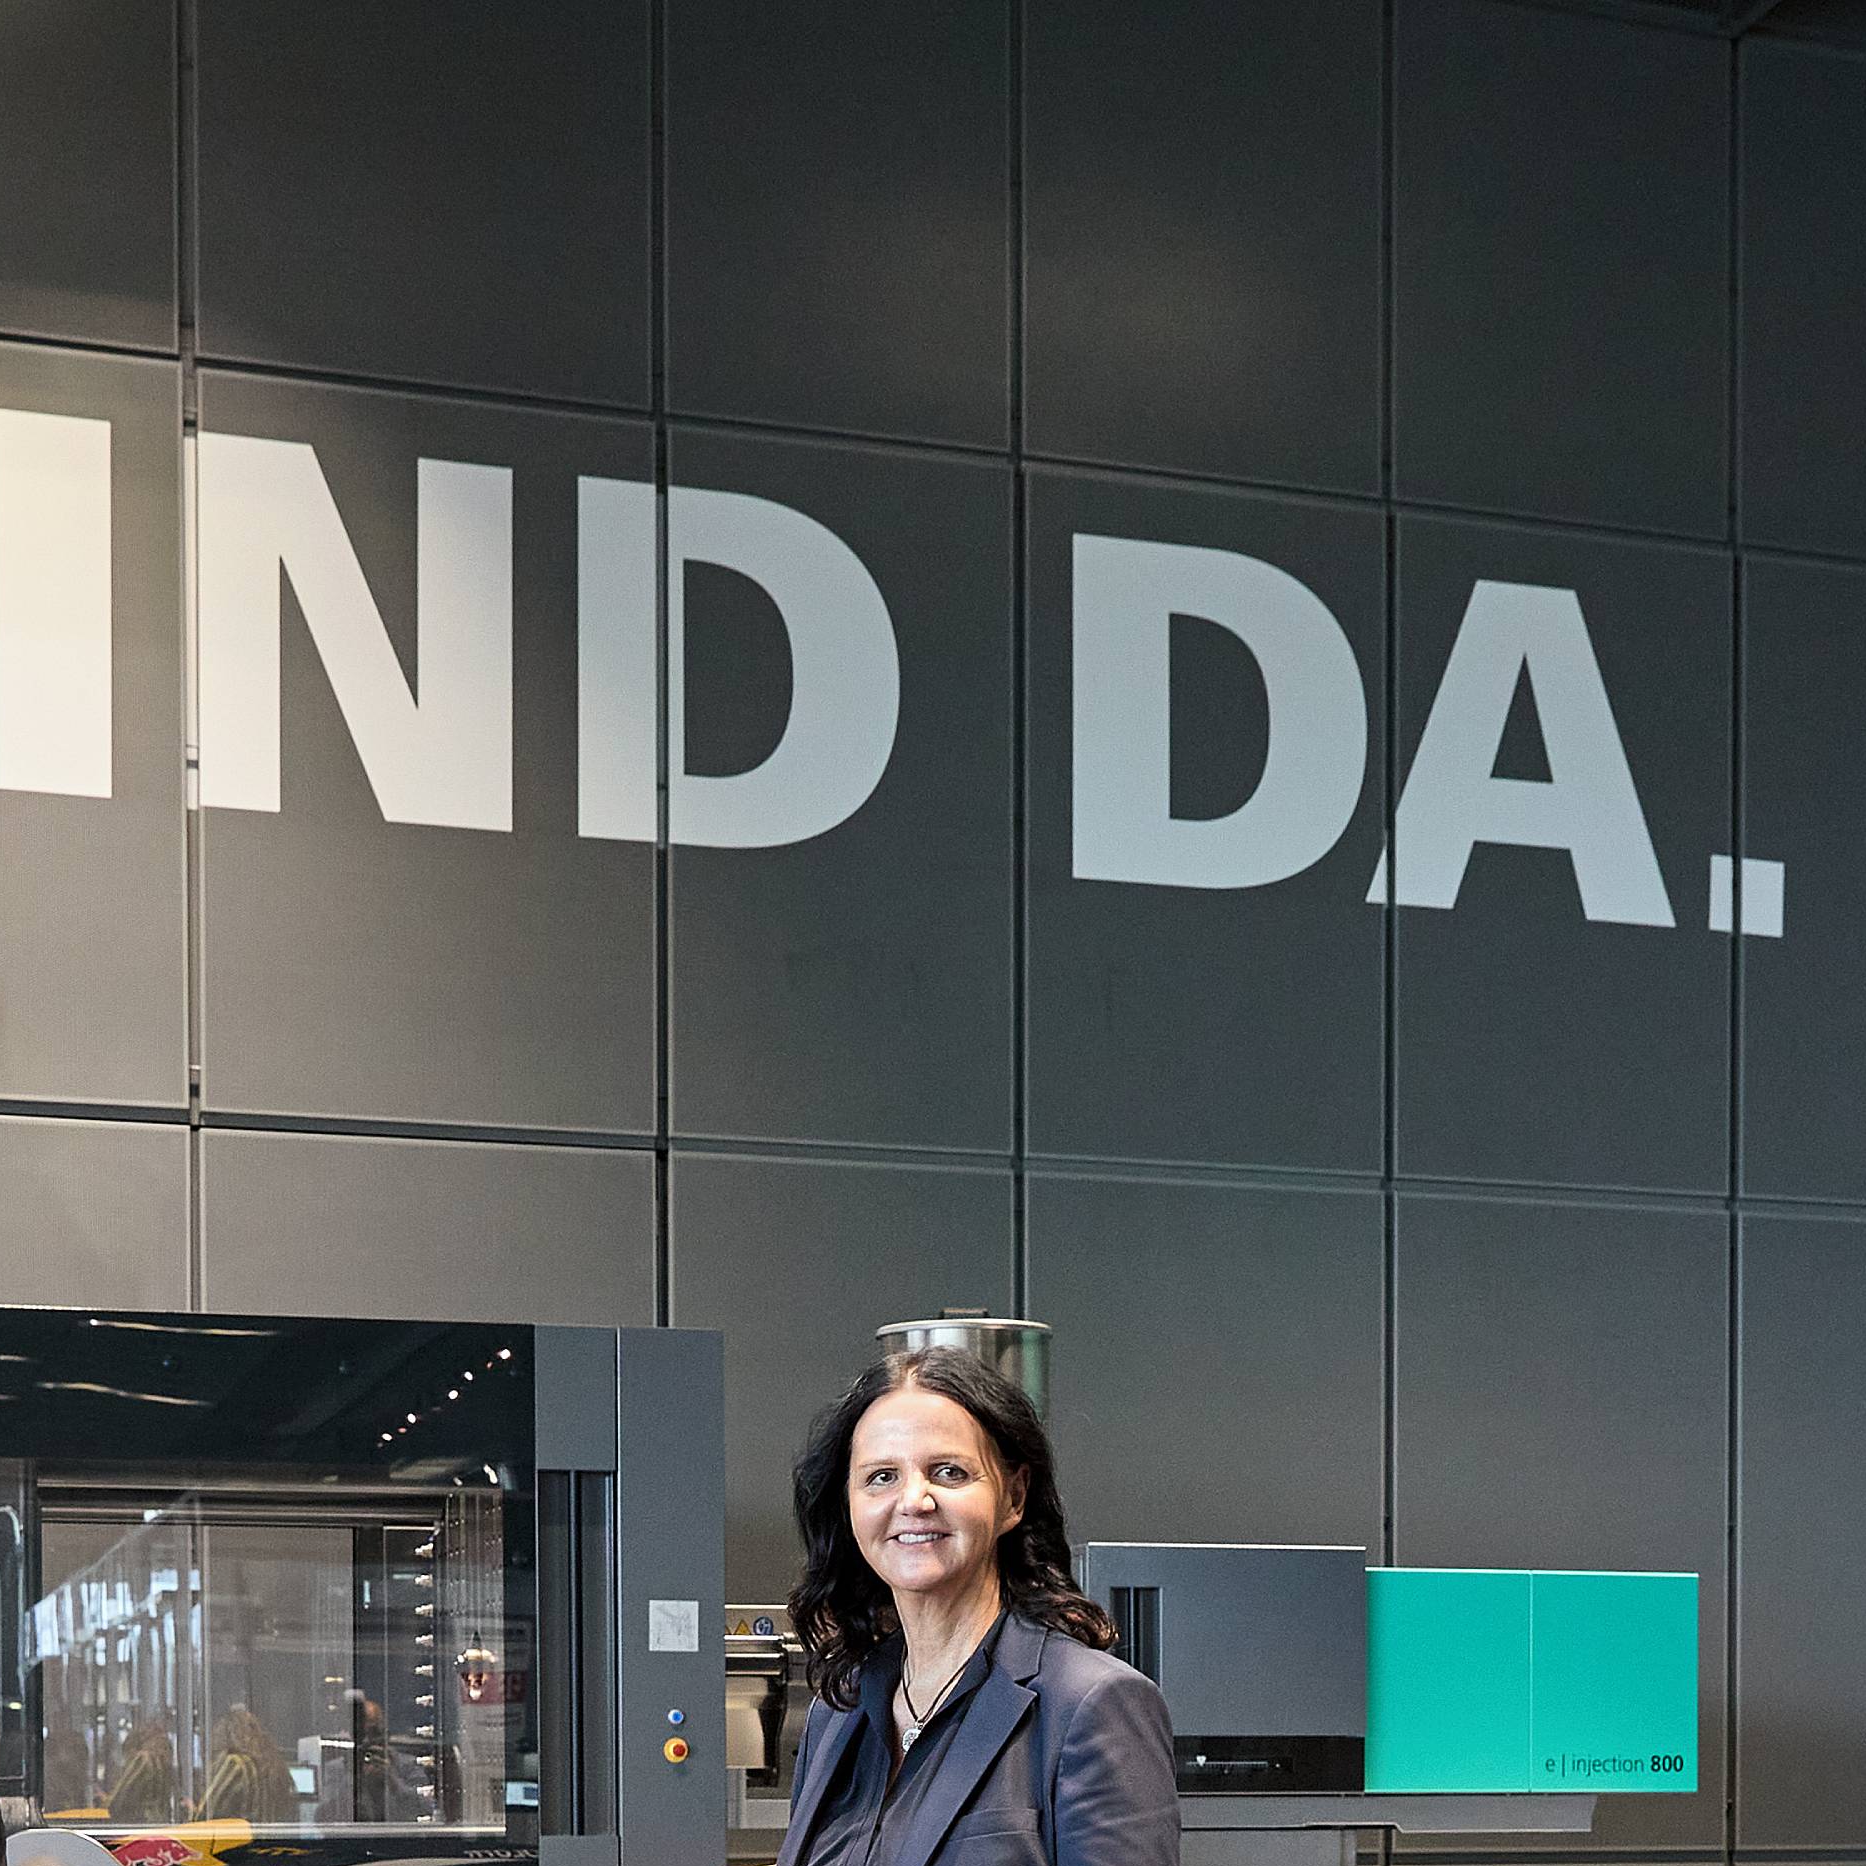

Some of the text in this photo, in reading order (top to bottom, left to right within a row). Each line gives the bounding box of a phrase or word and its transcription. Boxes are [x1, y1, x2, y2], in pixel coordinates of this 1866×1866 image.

[1072, 533, 1785, 938] DA.
[1545, 1758, 1556, 1772] e
[1572, 1755, 1644, 1777] injection
[1650, 1755, 1684, 1773] 800
